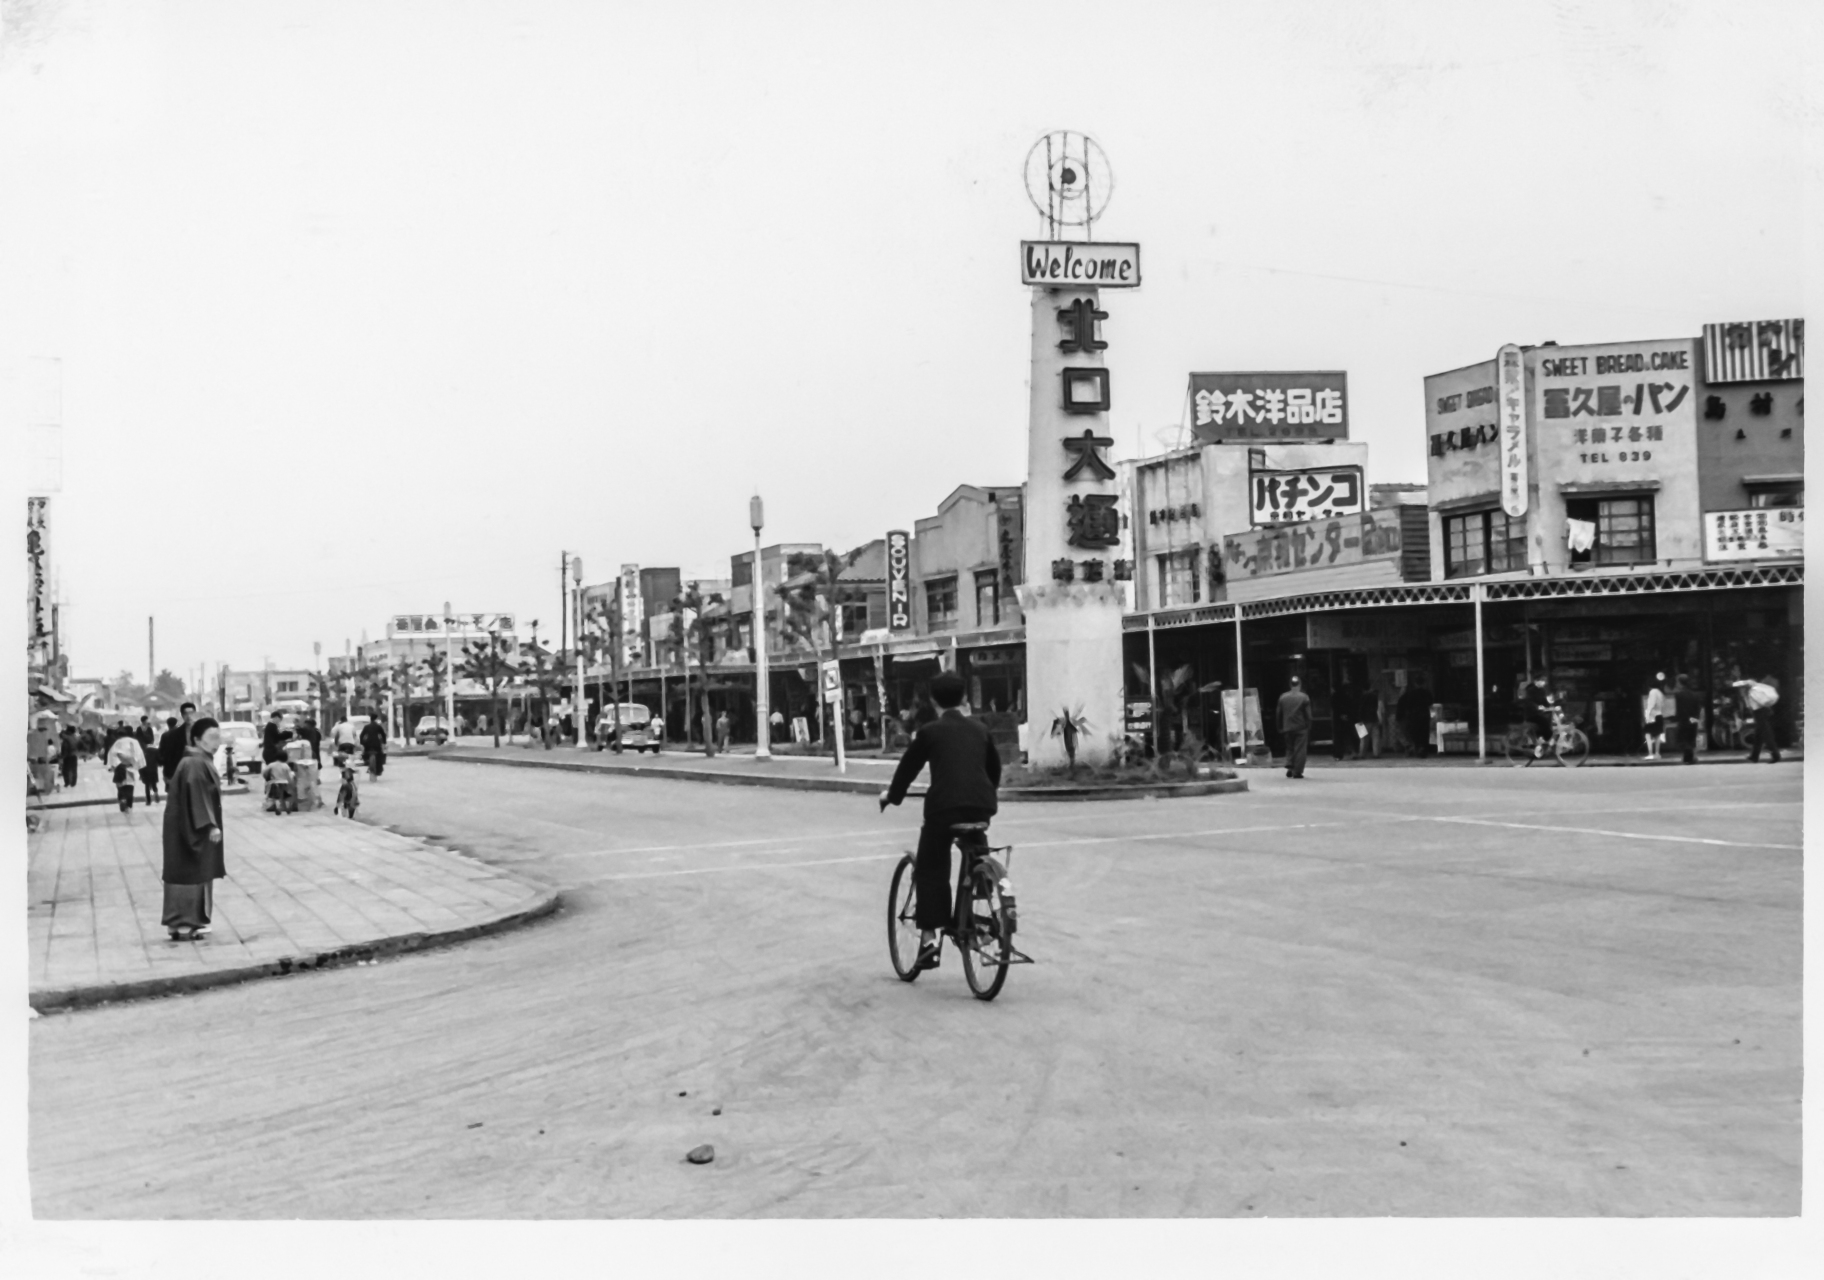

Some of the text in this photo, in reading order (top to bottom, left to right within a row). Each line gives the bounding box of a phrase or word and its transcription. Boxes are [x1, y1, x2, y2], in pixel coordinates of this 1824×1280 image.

[1027, 245, 1131, 280] Welcome
[1542, 357, 1588, 376] SWEET
[1596, 353, 1644, 374] BREAD
[1651, 351, 1689, 371] CAKE
[1057, 298, 1120, 549] 北口大通
[1195, 388, 1343, 425] 鈴木洋品店
[1580, 453, 1609, 463] TEL
[1256, 474, 1358, 511] パチンコ
[891, 534, 908, 627] SOUVENIR
